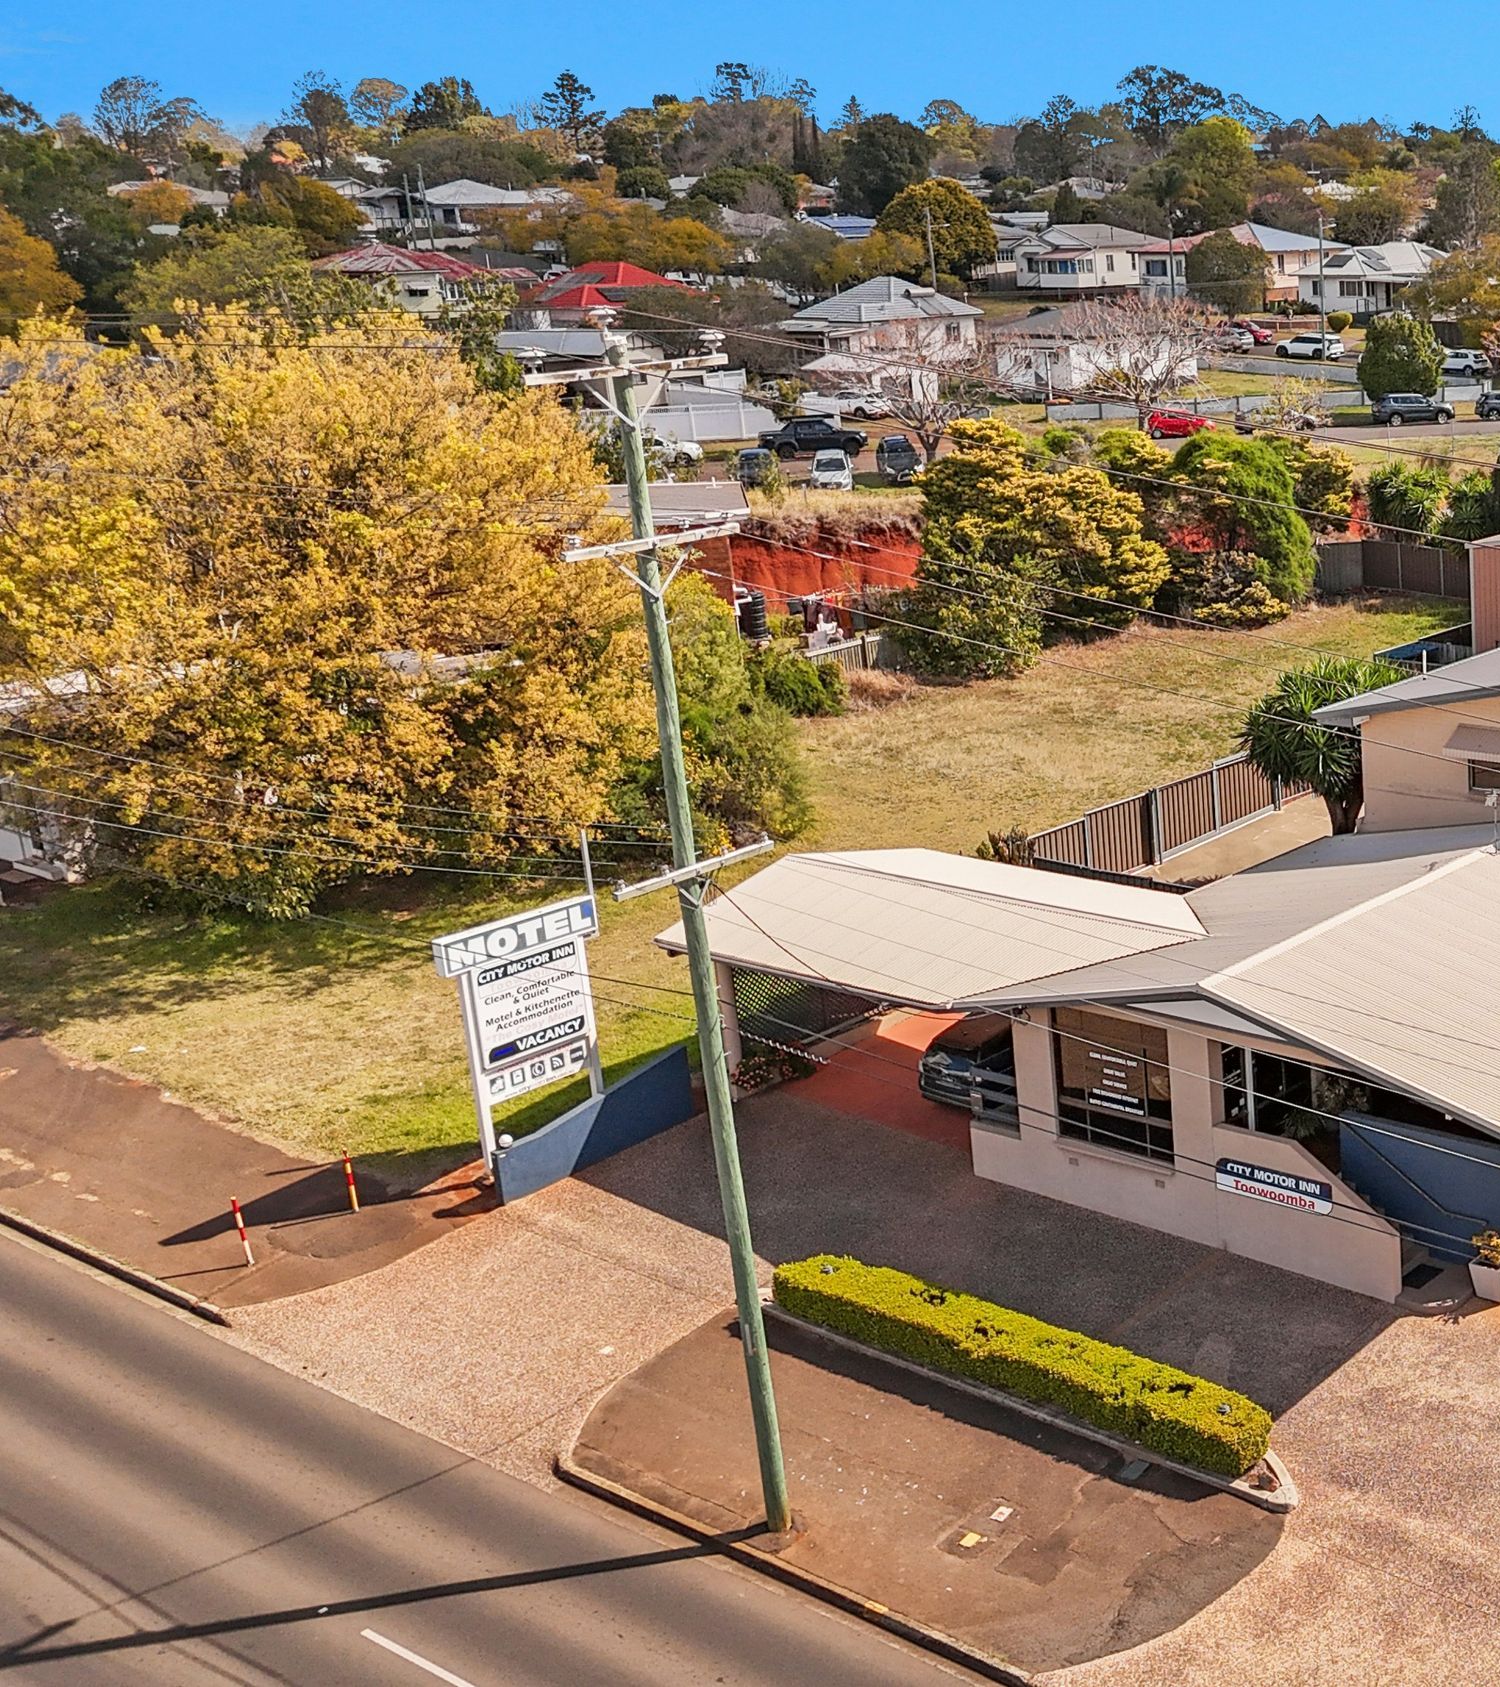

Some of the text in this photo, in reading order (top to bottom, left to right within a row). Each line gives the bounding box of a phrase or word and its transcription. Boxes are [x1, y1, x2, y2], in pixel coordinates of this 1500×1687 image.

[447, 904, 592, 971] MOTEL
[478, 944, 575, 984] CITY MOTOR INN
[484, 971, 575, 1006] Clean, Comfortable
[513, 987, 549, 1005] & Quiet
[485, 989, 580, 1027] Motel & Kitchenette
[495, 1000, 573, 1032] Accommodation
[516, 1018, 581, 1050] VACANCY
[1226, 1162, 1321, 1195] CITY MOTOR INN
[1233, 1178, 1316, 1210] Toowoomba
